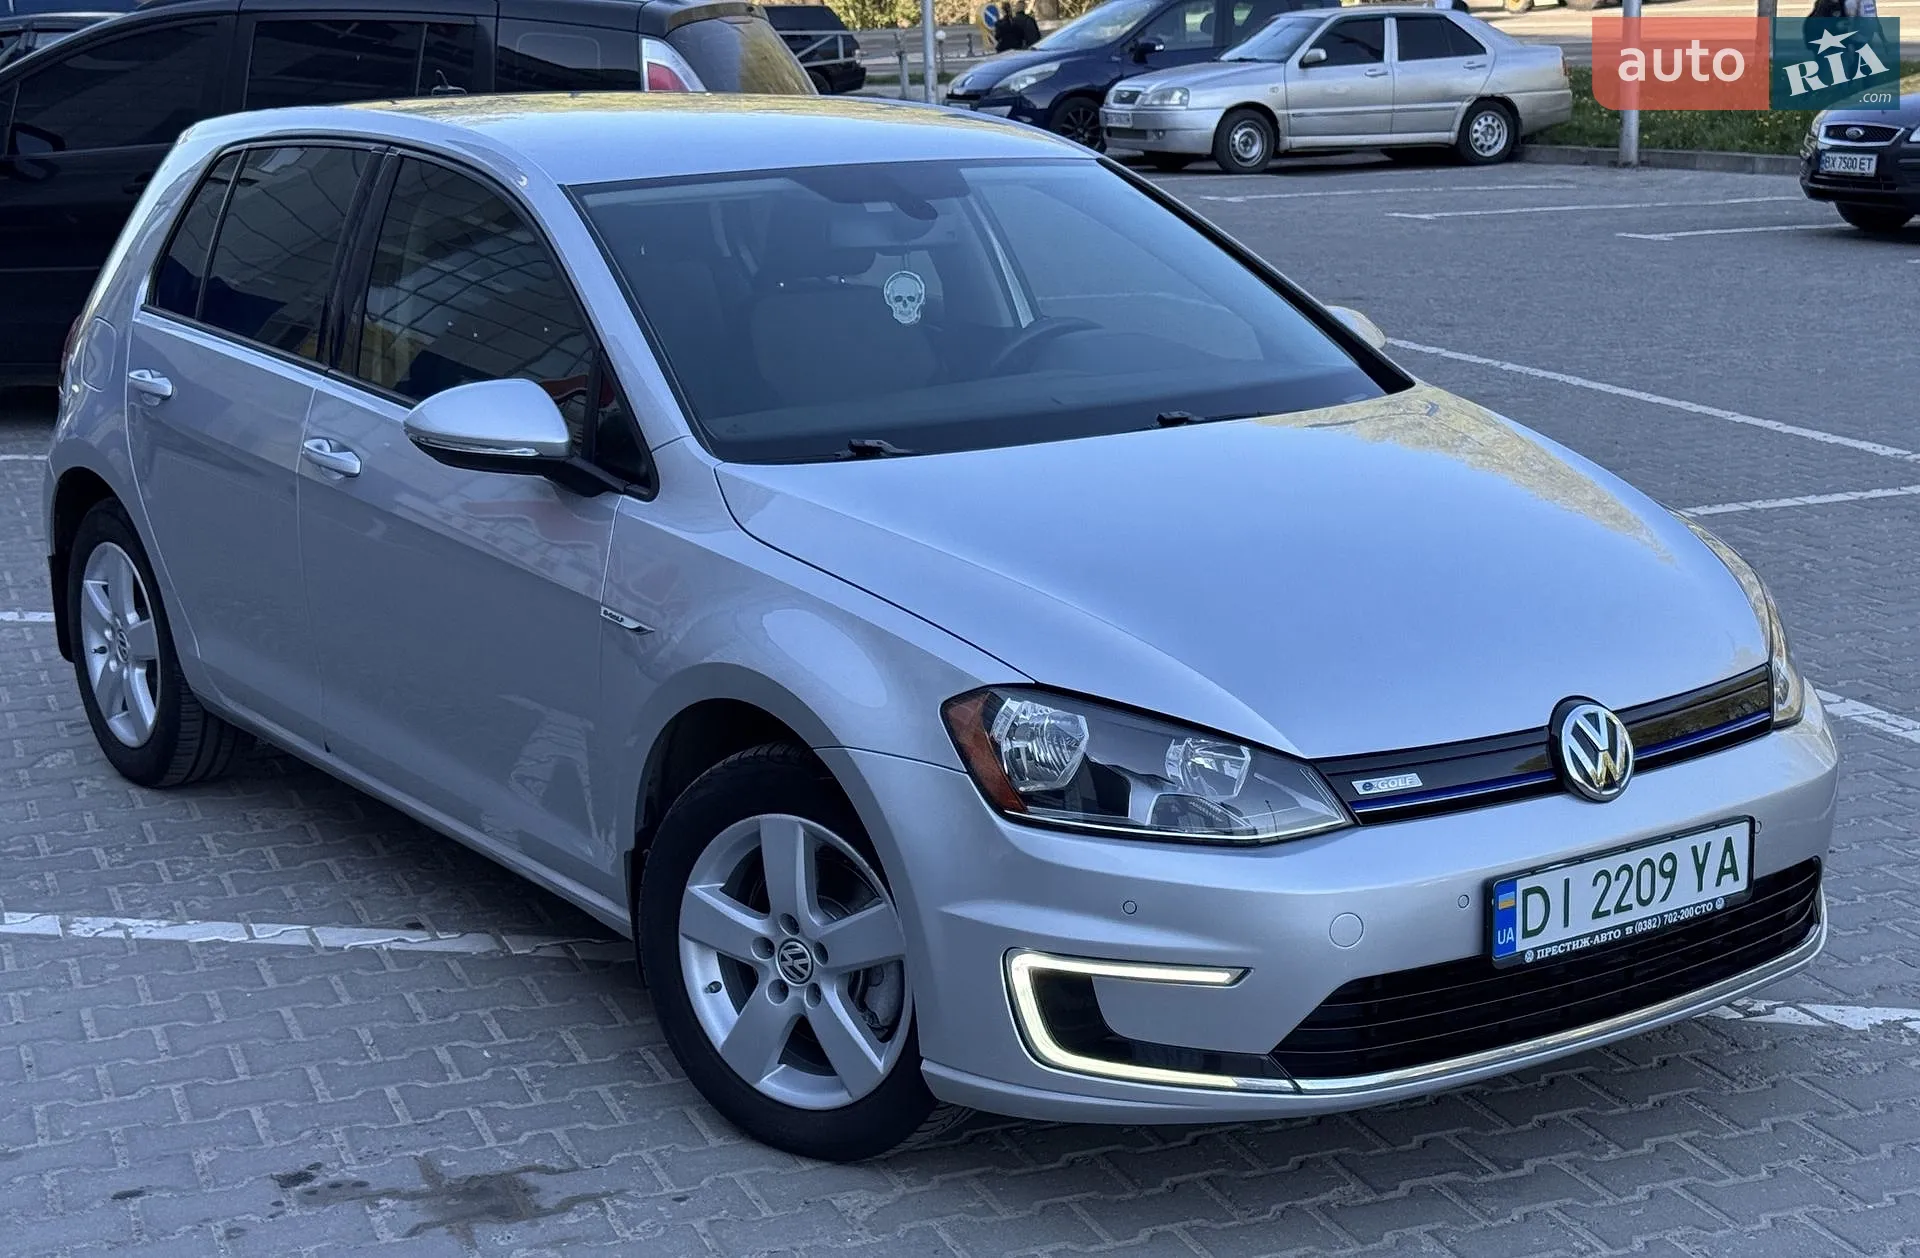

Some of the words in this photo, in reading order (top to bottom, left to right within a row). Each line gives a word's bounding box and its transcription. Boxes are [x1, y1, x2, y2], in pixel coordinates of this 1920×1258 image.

[1859, 158, 1874, 170] ET
[1521, 877, 1570, 940] DI
[1591, 851, 1678, 920] 2209
[1690, 836, 1740, 893] YA
[1497, 927, 1515, 945] UA
[1536, 929, 1621, 960] ПРЕСТИЖ-АВТО
[1634, 916, 1662, 934] (0382)
